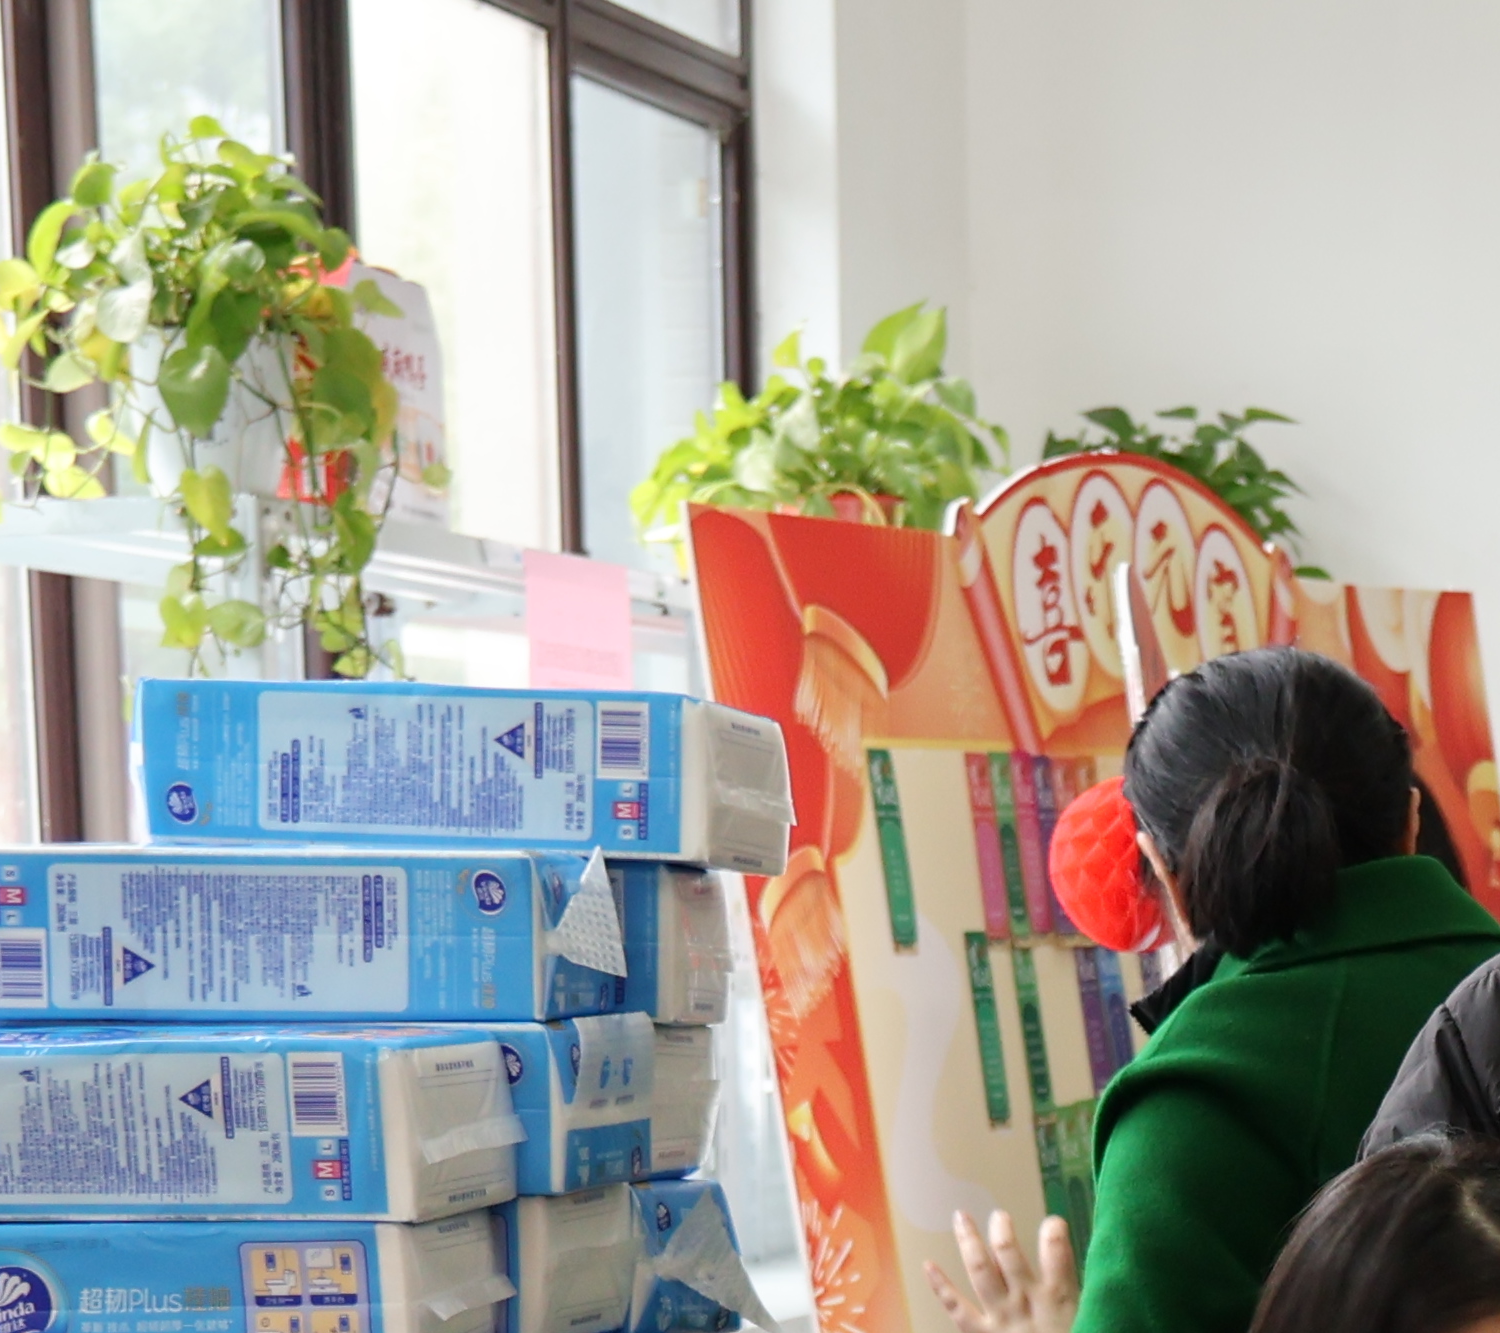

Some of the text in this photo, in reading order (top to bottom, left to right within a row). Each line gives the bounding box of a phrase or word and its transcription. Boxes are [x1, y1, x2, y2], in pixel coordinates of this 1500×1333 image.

[617, 803, 632, 819] M
[6, 888, 22, 904] M
[318, 1161, 333, 1178] M
